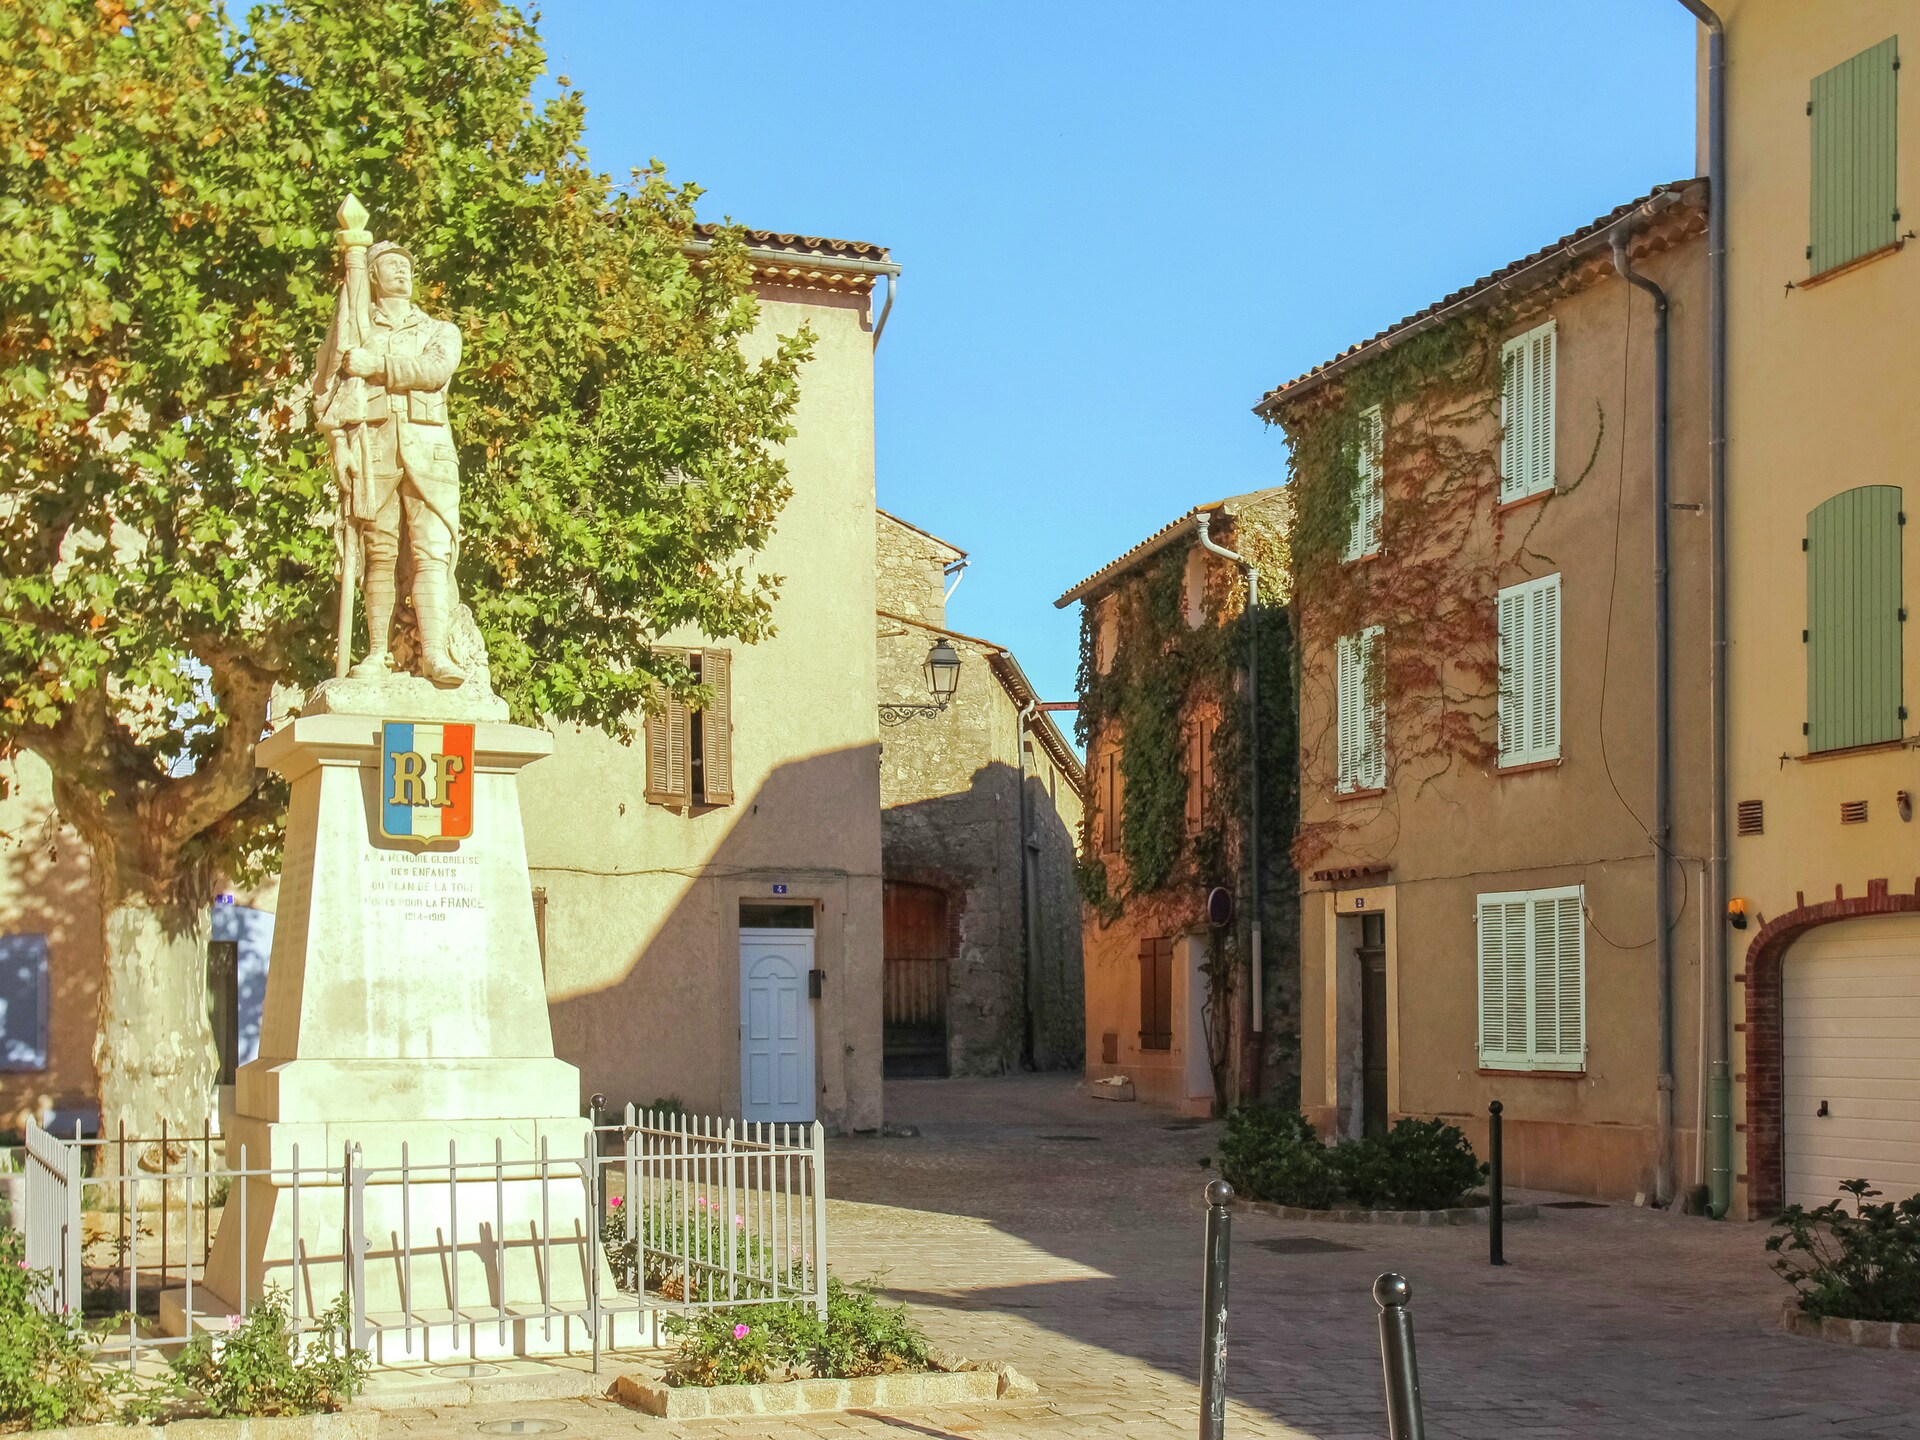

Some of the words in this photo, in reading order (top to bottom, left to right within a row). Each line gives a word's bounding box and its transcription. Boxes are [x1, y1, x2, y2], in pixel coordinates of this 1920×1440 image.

[389, 751, 464, 807] RF
[391, 867, 409, 876] DES
[412, 867, 457, 877] ENFANTS
[426, 899, 438, 908] LA
[441, 896, 485, 909] FRANCE
